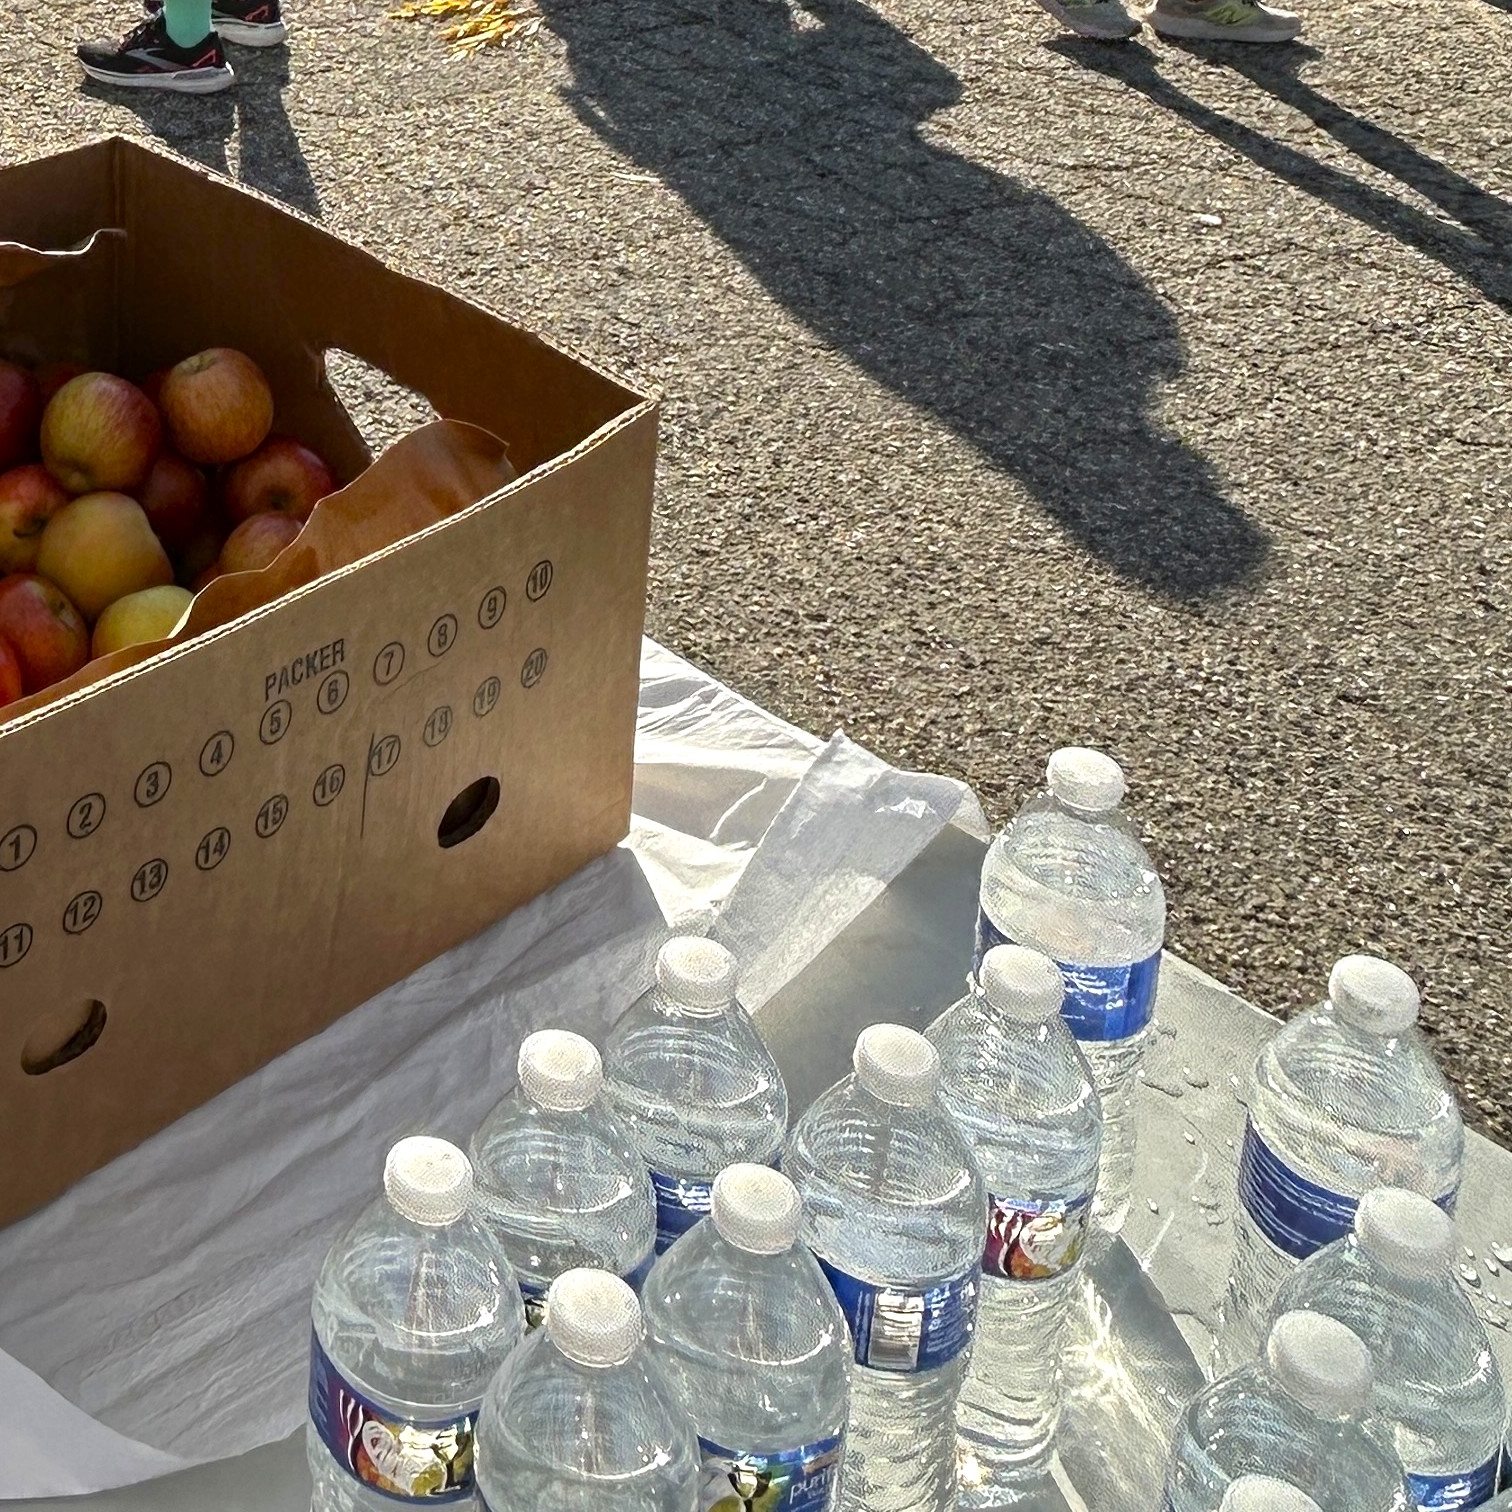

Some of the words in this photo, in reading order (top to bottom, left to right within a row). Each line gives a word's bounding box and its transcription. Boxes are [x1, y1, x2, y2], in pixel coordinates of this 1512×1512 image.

[531, 565, 548, 594] 10
[264, 638, 345, 703] PACKER
[67, 895, 96, 927] 12
[136, 863, 162, 896] 13
[199, 831, 225, 865] 14
[259, 800, 283, 831] 15
[317, 768, 341, 799] 16
[373, 739, 398, 770] 17
[428, 710, 448, 740] 18
[479, 680, 497, 709] 19
[525, 653, 544, 681] 20
